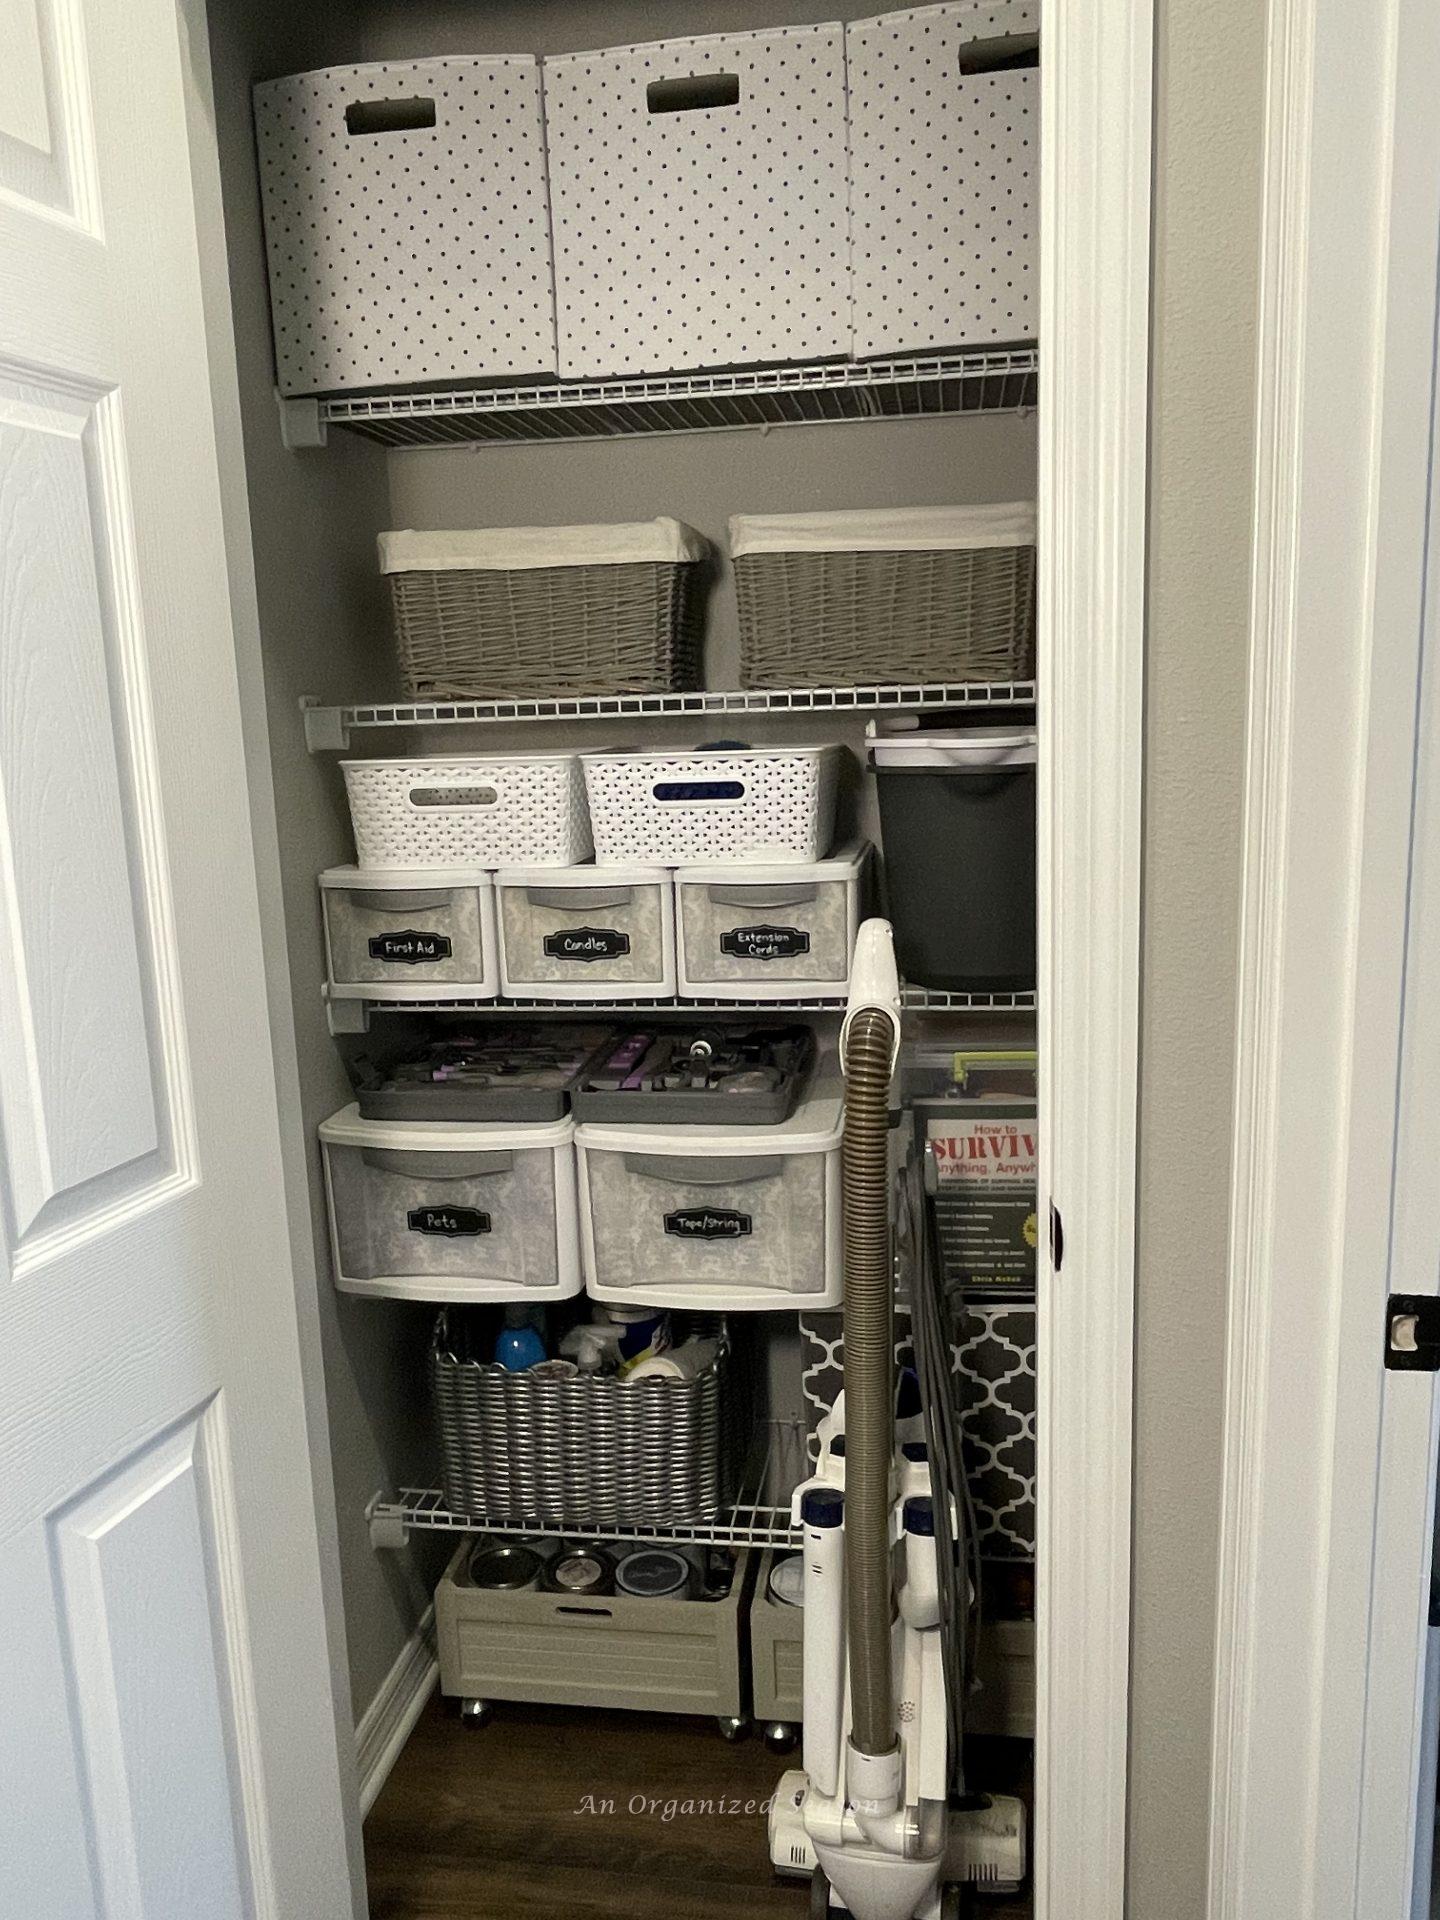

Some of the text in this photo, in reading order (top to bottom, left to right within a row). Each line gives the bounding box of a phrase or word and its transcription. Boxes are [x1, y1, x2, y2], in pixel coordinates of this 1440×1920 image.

[564, 937, 608, 952] Candles
[737, 932, 790, 943] Extension
[385, 941, 435, 954] First Aid
[974, 1124, 1018, 1135] How to
[426, 1213, 457, 1229] Pets
[677, 1214, 741, 1235] Tape/String
